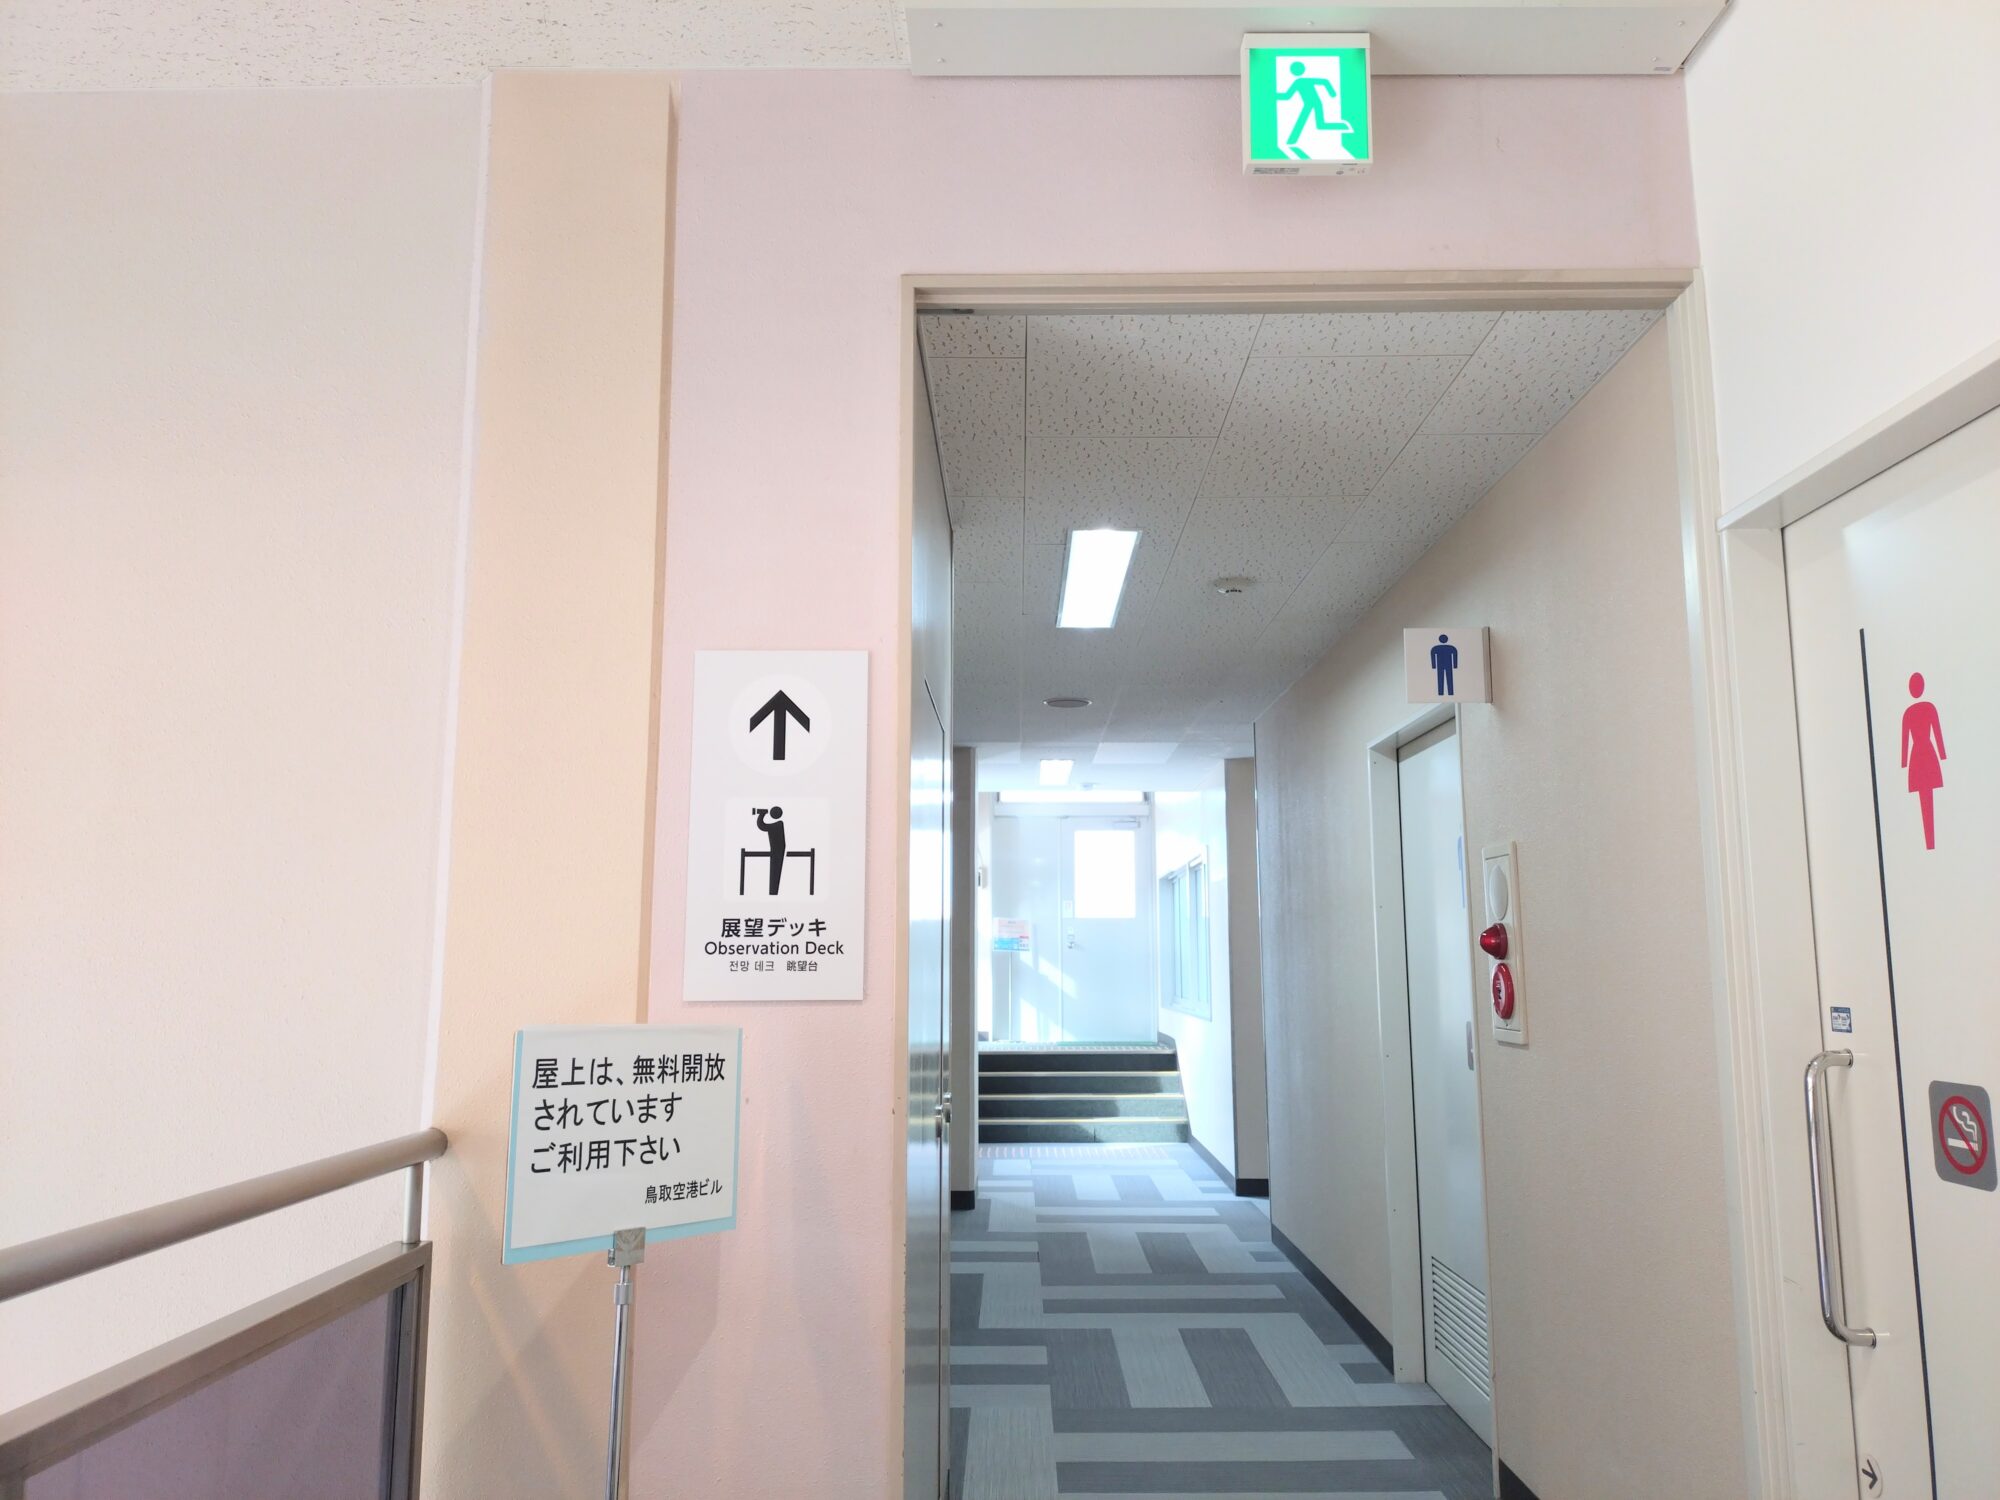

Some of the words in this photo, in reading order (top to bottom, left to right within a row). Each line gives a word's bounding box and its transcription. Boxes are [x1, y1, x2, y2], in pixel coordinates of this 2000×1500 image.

[721, 917, 827, 938] 展望デッキ
[704, 940, 800, 955] Observation
[805, 940, 845, 955] Deck
[729, 960, 750, 972] 전망
[754, 960, 775, 972] 데크
[786, 960, 818, 972] 眺望台
[531, 1052, 726, 1089] 屋上は、無料開放
[534, 1091, 683, 1132] されています
[530, 1134, 681, 1174] ご利用下さい
[644, 1177, 723, 1204] 鳥取空港ビル
